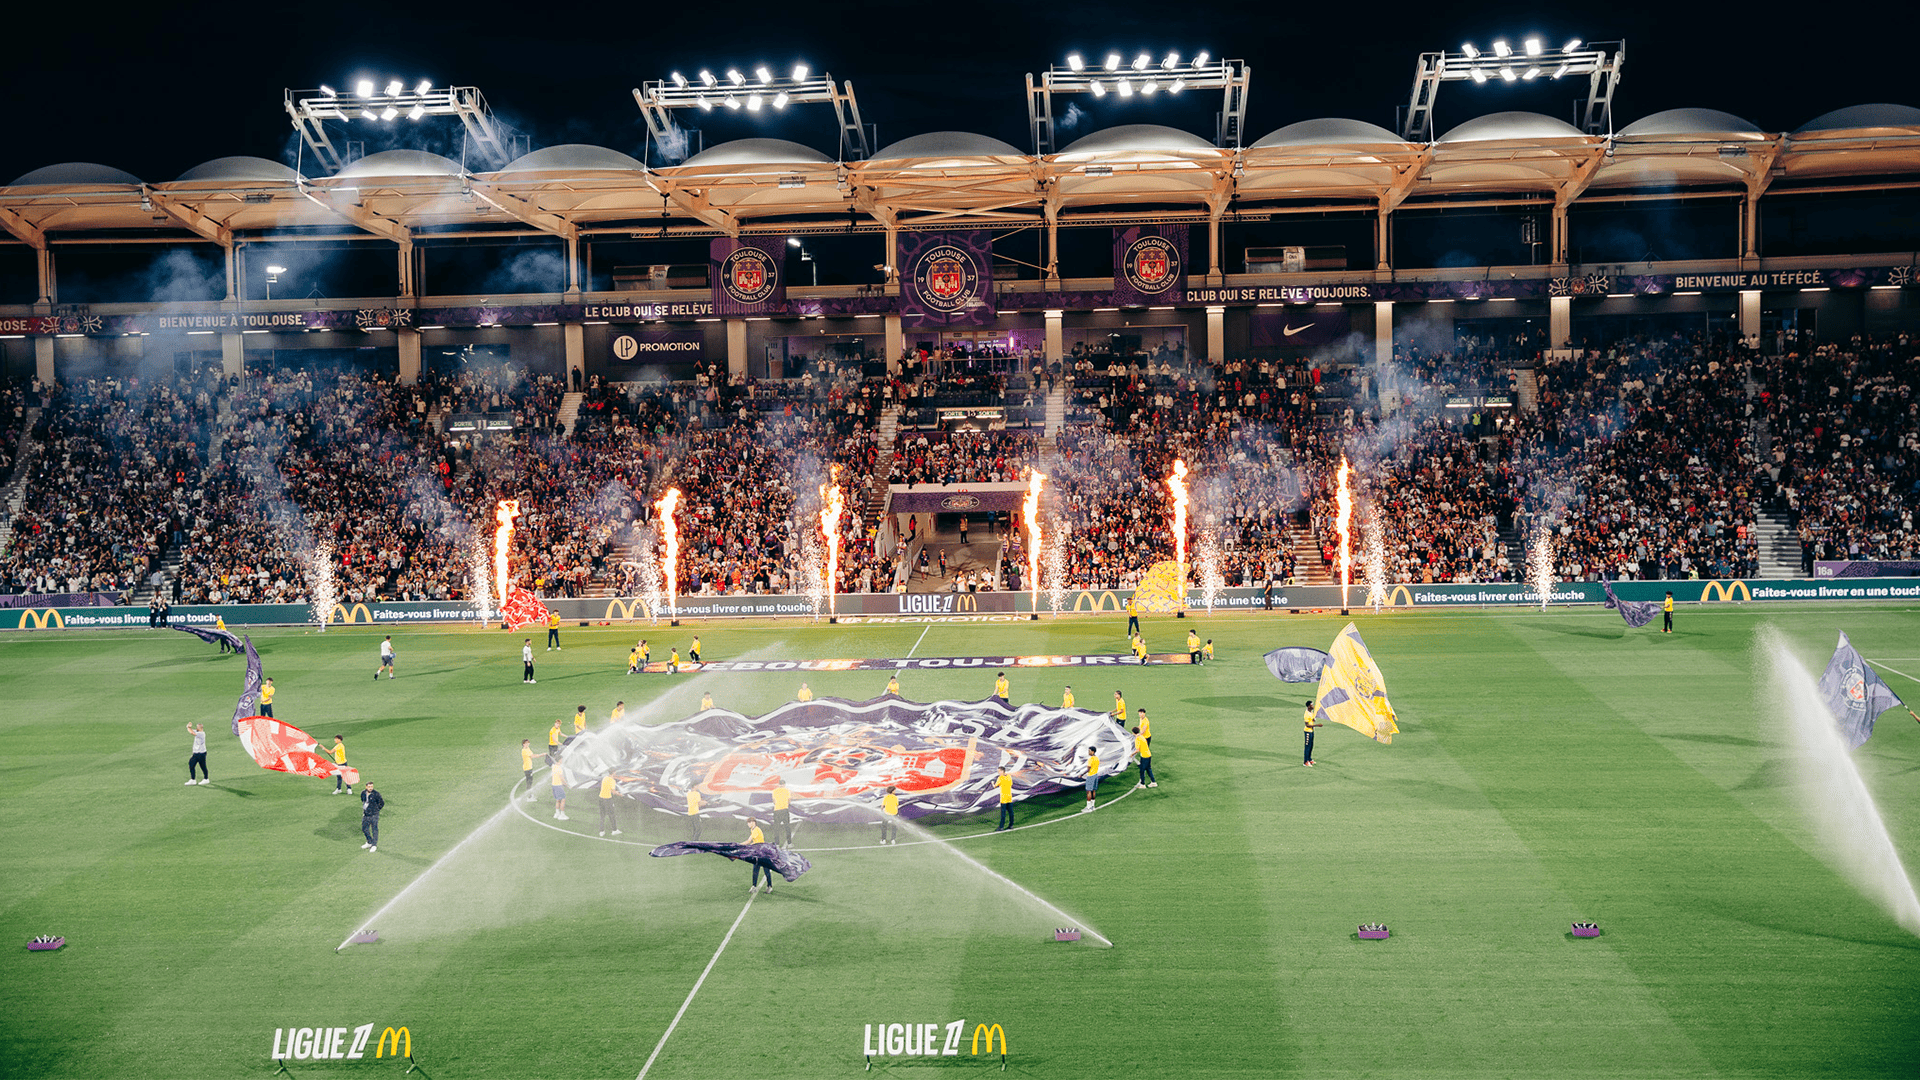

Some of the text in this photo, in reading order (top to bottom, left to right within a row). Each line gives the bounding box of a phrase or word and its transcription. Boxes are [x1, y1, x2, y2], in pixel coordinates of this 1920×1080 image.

[1133, 239, 1170, 251] TOULOUSE
[730, 250, 768, 262] TOULOUSE
[925, 249, 966, 264] TOULOUSE
[1131, 274, 1174, 290] FOOTBALL CLUB
[1676, 270, 1824, 288] BIENVENUE AU TÉFÉCÉ.
[728, 284, 772, 300] FOOTBALL CLUB
[922, 290, 955, 308] FOOTBALL
[955, 288, 971, 306] CLUB
[1187, 290, 1216, 302] CLUB
[1220, 290, 1238, 302] QUI
[1242, 289, 1256, 300] SE
[1259, 286, 1303, 299] RELÈVE
[1306, 286, 1370, 299] TOUJOURS.
[585, 306, 598, 318] LE
[602, 306, 630, 317] CLUB
[634, 306, 652, 318] QUI
[655, 306, 668, 316] SE
[672, 302, 713, 315] RELÈVE
[160, 313, 306, 328] BIENVENUE À TOULOUSE.
[640, 342, 700, 352] PROMOTION
[1473, 396, 1484, 407] 14
[477, 420, 487, 430] 11
[1817, 566, 1833, 576] 16a
[1415, 592, 1477, 602] Faites-vous
[1479, 592, 1507, 601] livrer
[1508, 593, 1521, 601] en
[1752, 587, 1817, 597] Faites-vous
[1819, 586, 1849, 597] livrer
[1850, 588, 1864, 597] en
[1866, 587, 1888, 596] une
[899, 595, 941, 612] LIGUE
[1184, 596, 1212, 606] livre
[374, 610, 432, 620] Faites-vous
[434, 608, 460, 618] livrer
[461, 610, 474, 618] en
[651, 605, 710, 614] aits-vous
[713, 604, 739, 612] livrer
[776, 603, 812, 612] touche
[65, 614, 123, 625] Faites-vous
[124, 613, 150, 624] livrer
[167, 614, 185, 623] une
[678, 656, 1163, 671] DEBOUT. TOUJOURS.
[272, 1027, 348, 1059] LIGUE
[864, 1023, 938, 1056] LIGUE
